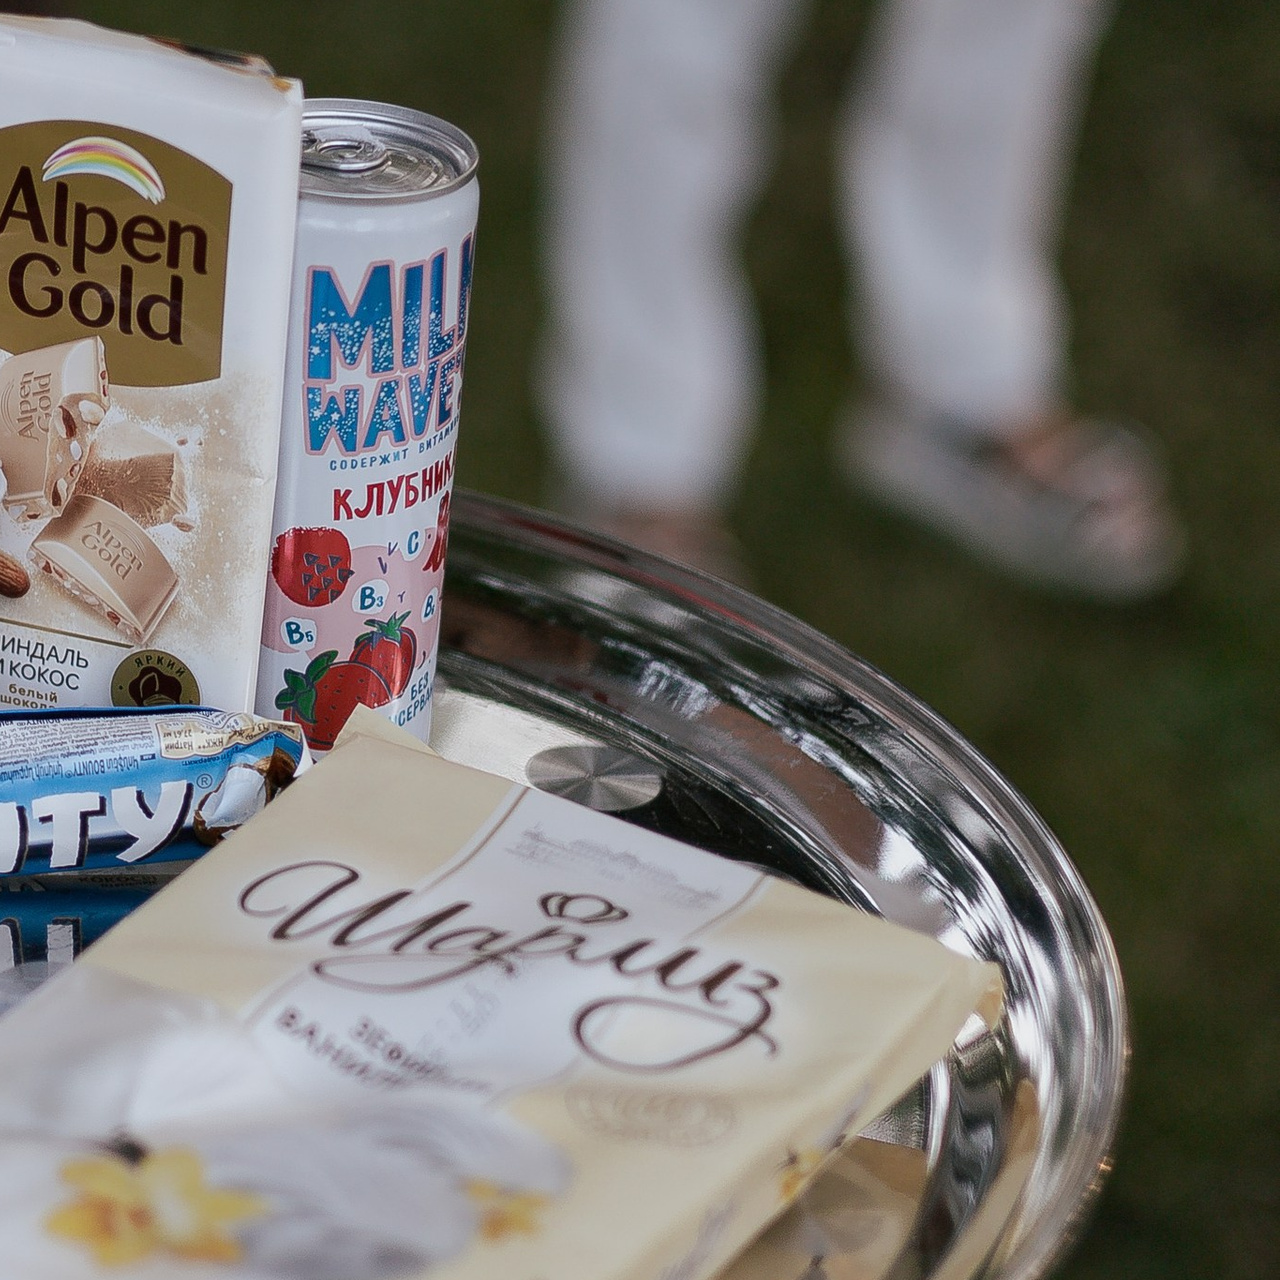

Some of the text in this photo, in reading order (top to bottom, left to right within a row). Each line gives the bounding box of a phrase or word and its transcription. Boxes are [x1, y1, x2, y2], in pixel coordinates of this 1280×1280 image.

[8, 252, 184, 346] Gold
[17, 371, 40, 442] Alpen
[33, 372, 52, 434] Gold
[302, 349, 463, 455] WAVE
[330, 448, 409, 471] СОДЕРЖИТ
[333, 446, 455, 521] КЛУБНИК
[82, 534, 133, 580] Gold
[83, 521, 144, 571] Alpen
[9, 660, 80, 690] КОКОС
[134, 655, 186, 677] ЯРКИЙ
[411, 671, 428, 700] БЕЗ
[9, 683, 58, 703] белый
[164, 740, 193, 753] Натрий
